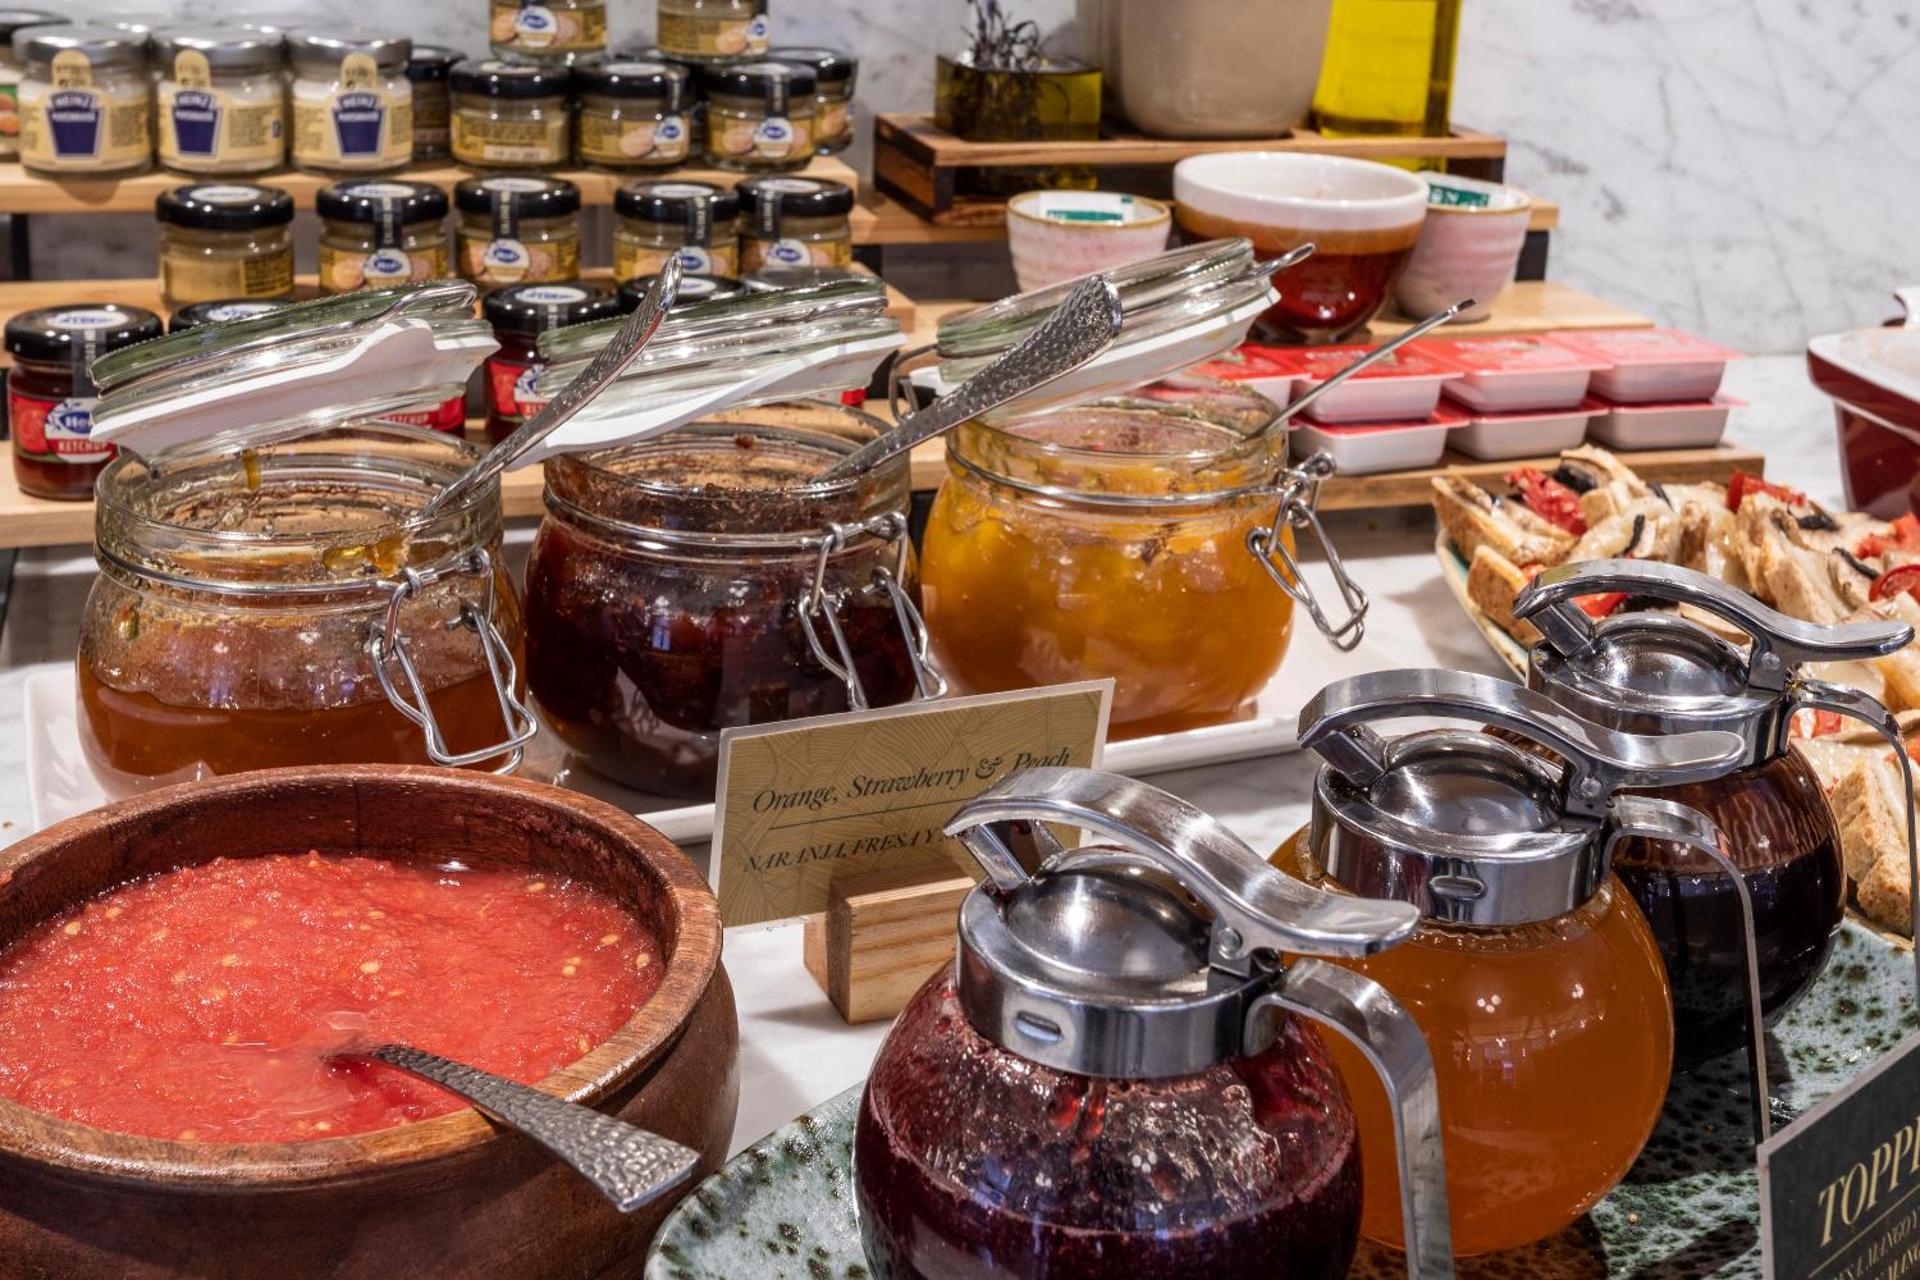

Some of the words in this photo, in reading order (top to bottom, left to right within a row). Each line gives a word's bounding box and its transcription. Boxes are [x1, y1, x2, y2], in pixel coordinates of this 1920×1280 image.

[753, 785, 838, 813] Orange,
[847, 764, 970, 798] Strawberry
[975, 757, 1003, 779] &
[1011, 747, 1071, 771] Peach
[852, 831, 919, 855] FRESA
